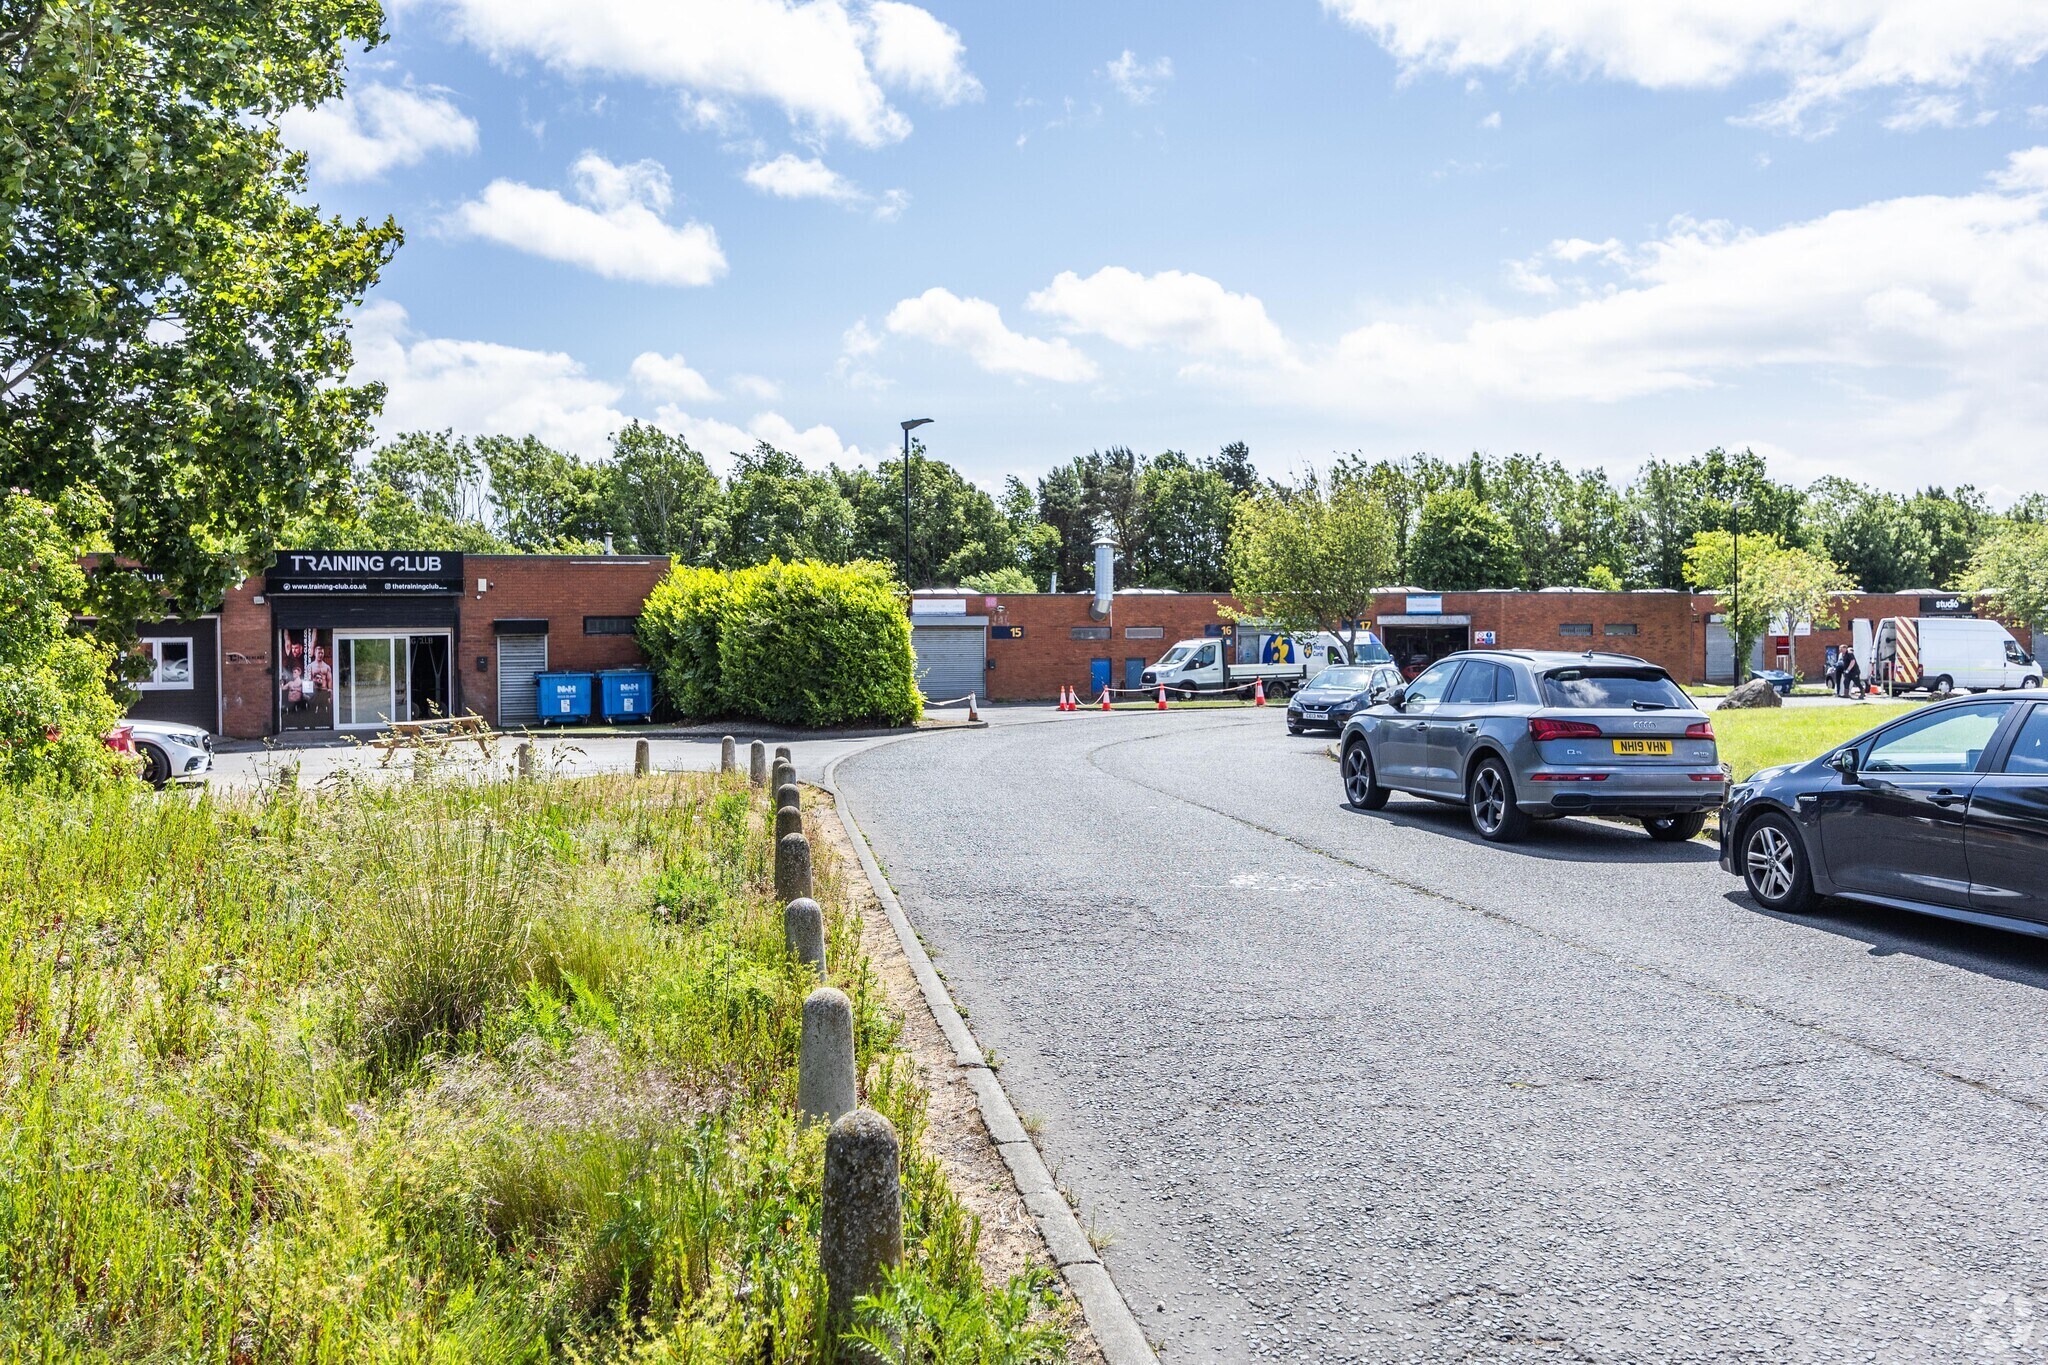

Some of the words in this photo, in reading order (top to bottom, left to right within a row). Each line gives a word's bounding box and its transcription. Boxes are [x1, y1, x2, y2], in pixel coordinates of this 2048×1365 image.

[290, 555, 384, 572] TRAINING
[390, 556, 442, 572] CLUB
[292, 582, 367, 591] www.training-club.co.uk
[1221, 625, 1232, 635] 16
[1359, 621, 1372, 630] 17
[1010, 627, 1022, 638] 15
[1620, 741, 1644, 752] NH19
[1646, 741, 1667, 752] VHN
